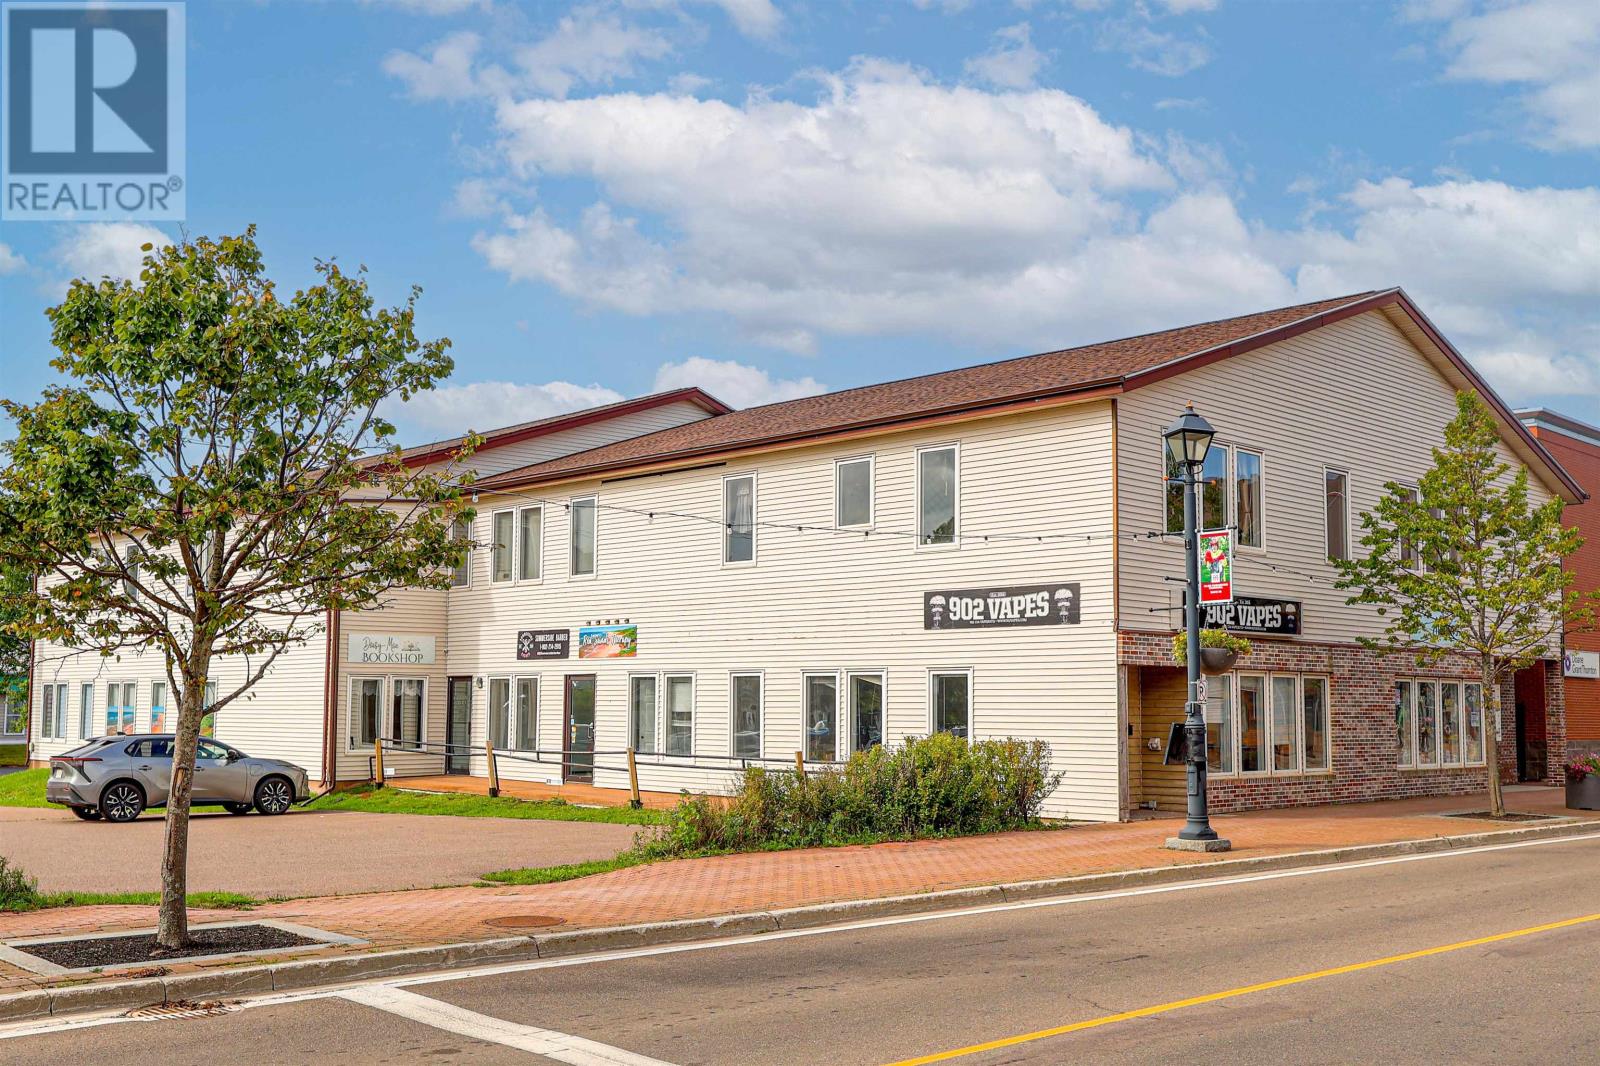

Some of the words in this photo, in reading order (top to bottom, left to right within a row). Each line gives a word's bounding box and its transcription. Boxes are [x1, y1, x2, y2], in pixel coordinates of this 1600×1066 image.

[949, 596, 985, 621] 902
[986, 590, 1050, 620] VAPES
[1237, 604, 1282, 628] VAPES
[362, 652, 424, 663] BOOKSHOP
